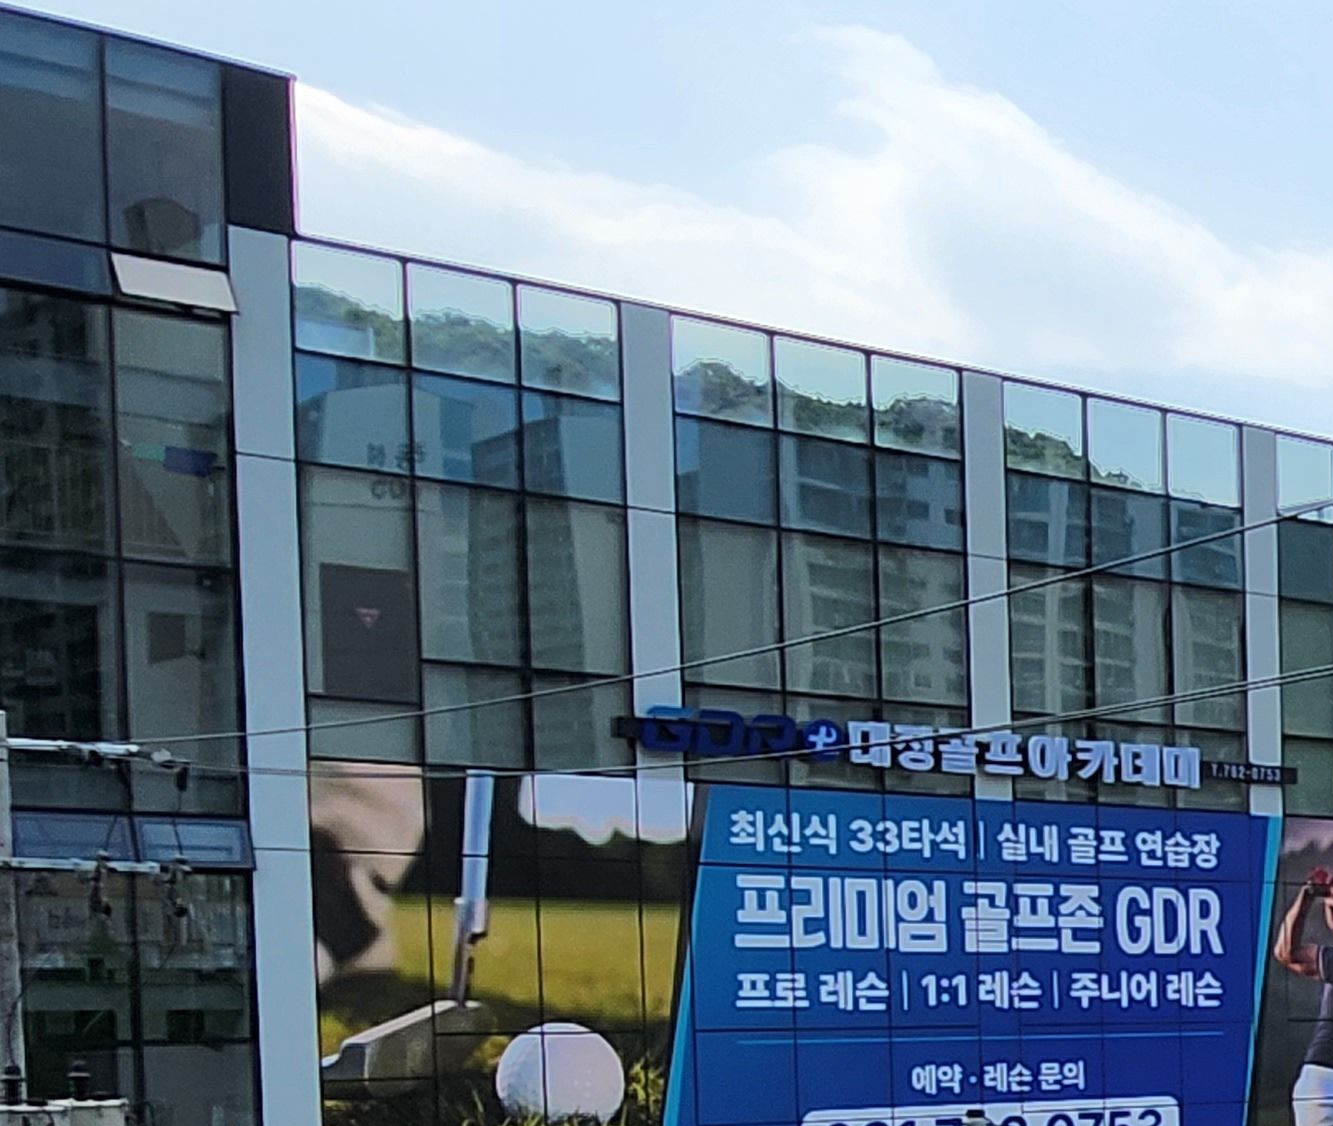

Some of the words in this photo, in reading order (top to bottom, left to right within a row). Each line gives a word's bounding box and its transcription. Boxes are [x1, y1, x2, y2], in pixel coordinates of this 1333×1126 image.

[847, 721, 1200, 789] 대정골프아카데미
[729, 809, 837, 853] 최신식
[849, 818, 966, 859] 33타석
[997, 822, 1059, 863] 실내
[1067, 827, 1128, 863] 골프
[1135, 830, 1221, 869] 연습장
[734, 873, 948, 954] 프리미엄
[961, 880, 1103, 954] 골프존
[1115, 886, 1224, 955] GDR
[735, 972, 810, 1008] 프로
[819, 970, 889, 1012] 레슨
[921, 975, 967, 1007] 1:1
[978, 970, 1042, 1010] 레슨
[1069, 971, 1158, 1009] 주니어
[1165, 970, 1223, 1008] 레슨
[911, 1063, 963, 1095] 예약
[983, 1063, 1033, 1092] 레슨
[1038, 1060, 1086, 1091] 문의
